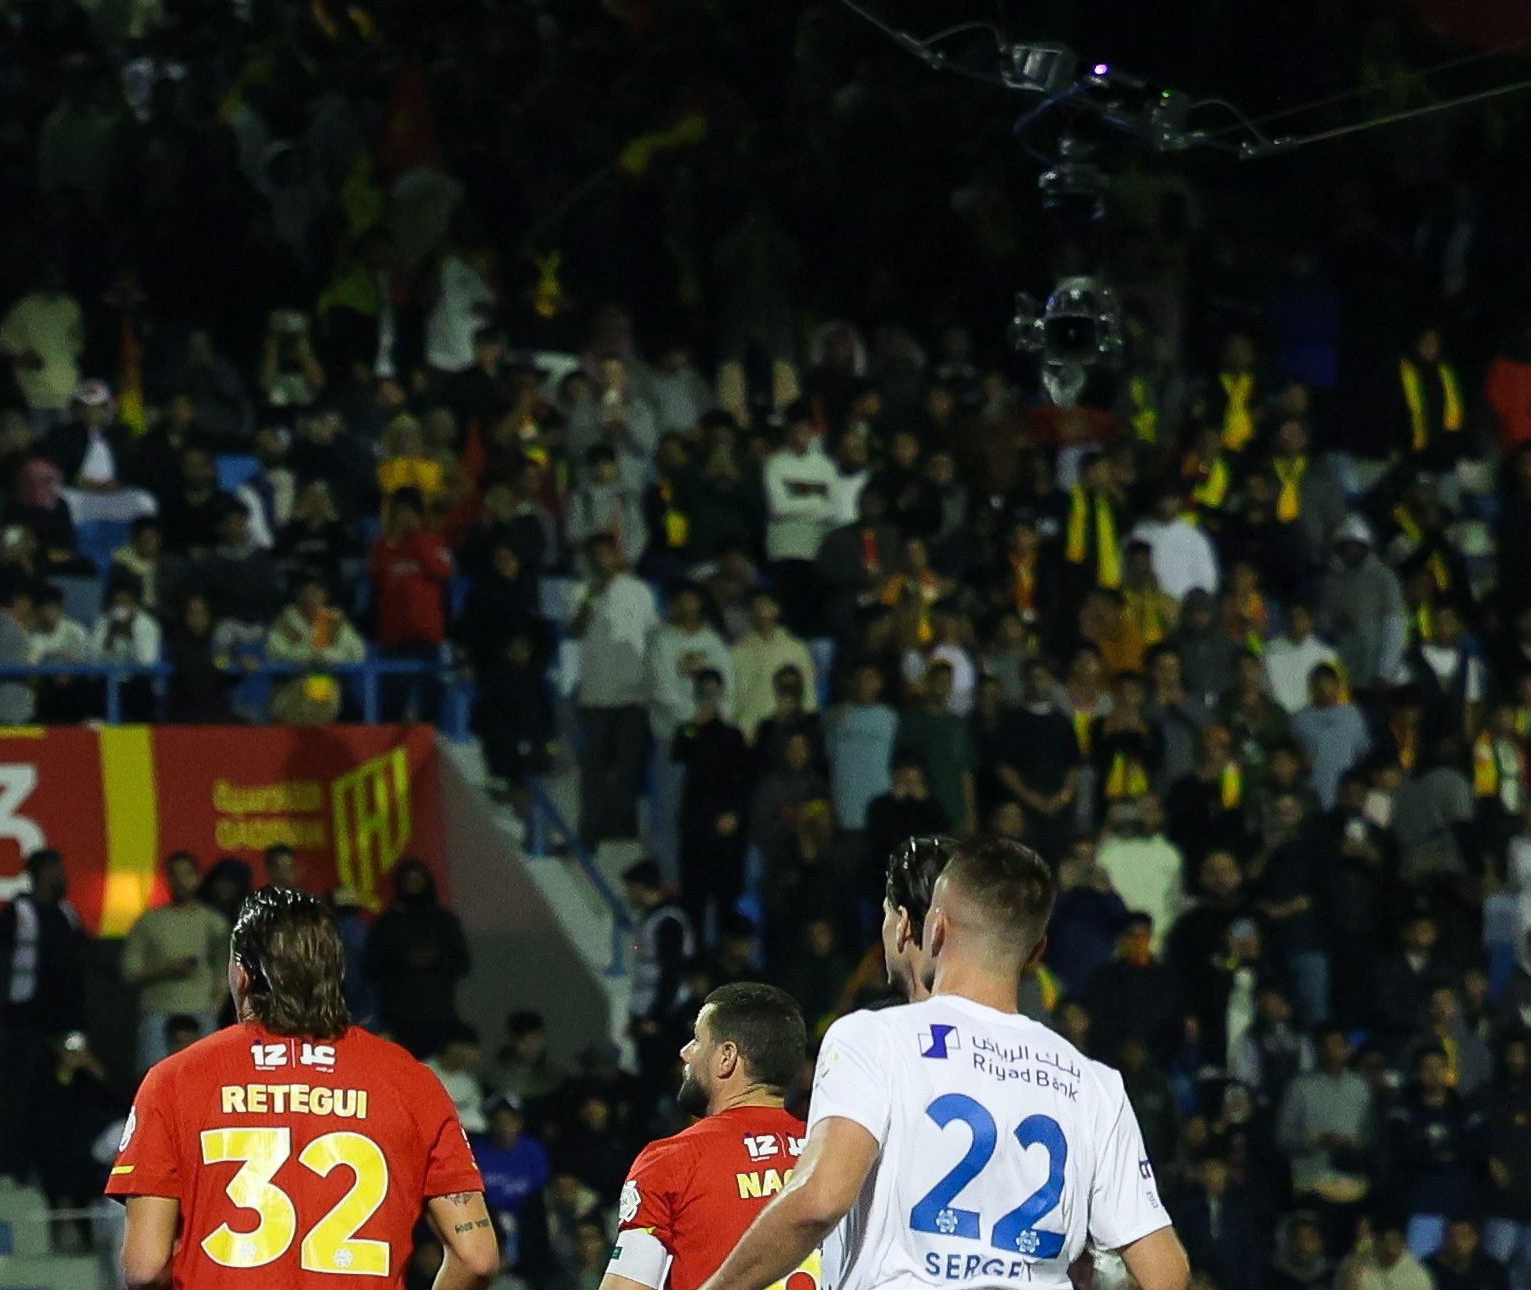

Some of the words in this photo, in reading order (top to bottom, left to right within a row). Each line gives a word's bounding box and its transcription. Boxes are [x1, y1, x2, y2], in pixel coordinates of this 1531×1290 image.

[221, 1084, 368, 1119] RETEGUI
[973, 1052, 1031, 1083] Riyad
[1036, 1069, 1080, 1102] Bank
[200, 1127, 390, 1277] 32
[910, 1093, 1069, 1260] 22
